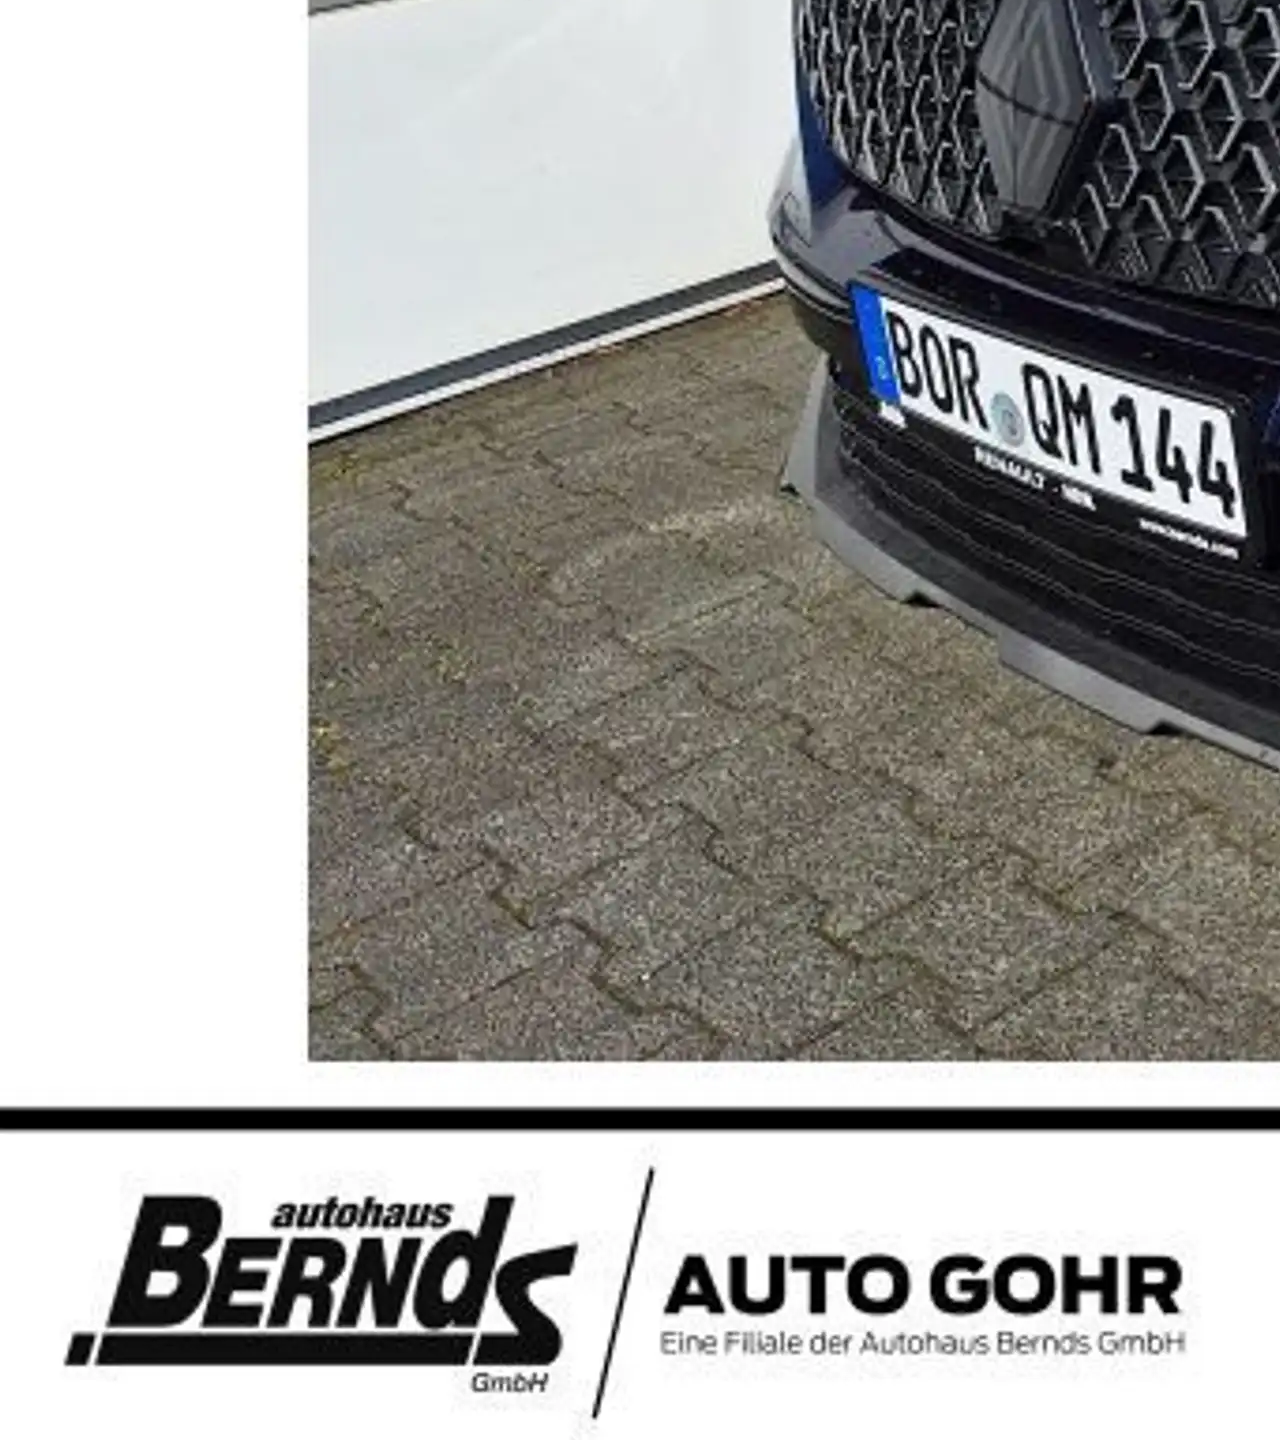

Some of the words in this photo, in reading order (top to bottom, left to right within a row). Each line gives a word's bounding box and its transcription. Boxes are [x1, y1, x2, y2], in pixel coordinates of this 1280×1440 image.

[886, 311, 989, 430] BOR
[1022, 363, 1101, 474] QM
[1110, 394, 1235, 518] 144
